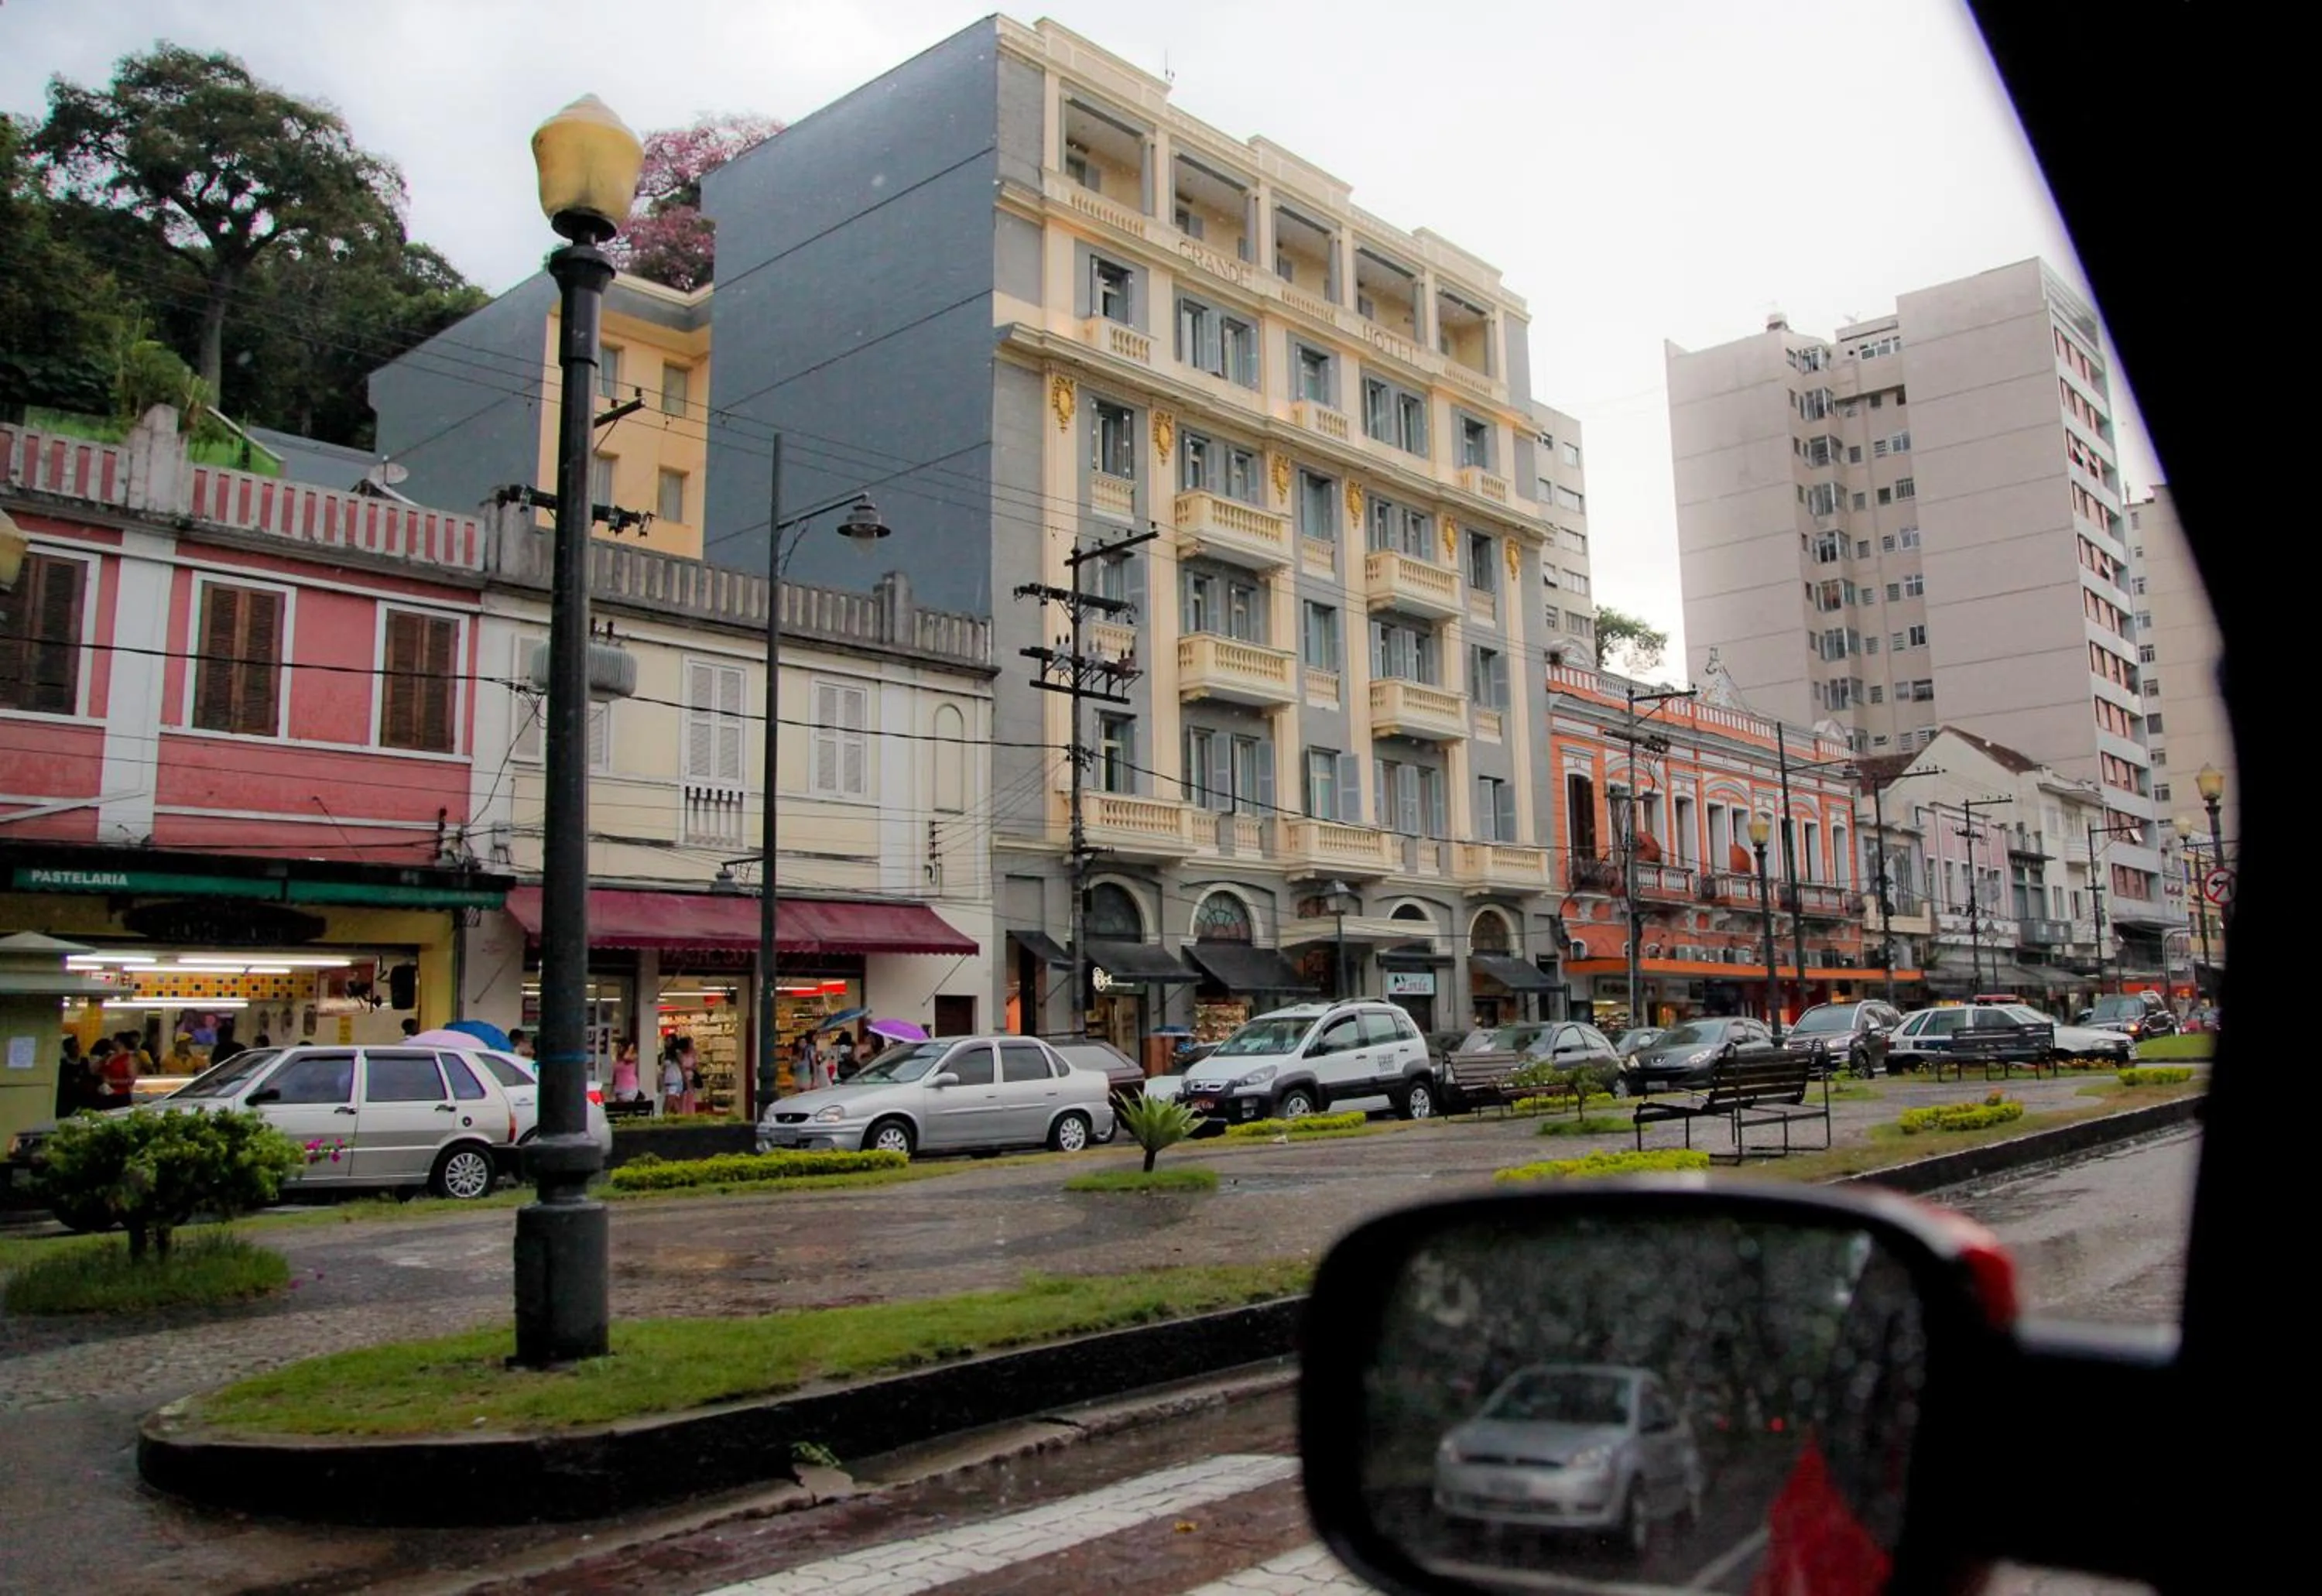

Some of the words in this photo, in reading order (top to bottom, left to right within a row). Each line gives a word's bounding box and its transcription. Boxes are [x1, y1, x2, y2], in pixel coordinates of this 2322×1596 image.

[1179, 240, 1252, 288] GRANDE
[1362, 324, 1416, 364] HOTEL
[32, 869, 128, 885] PASTELARIA
